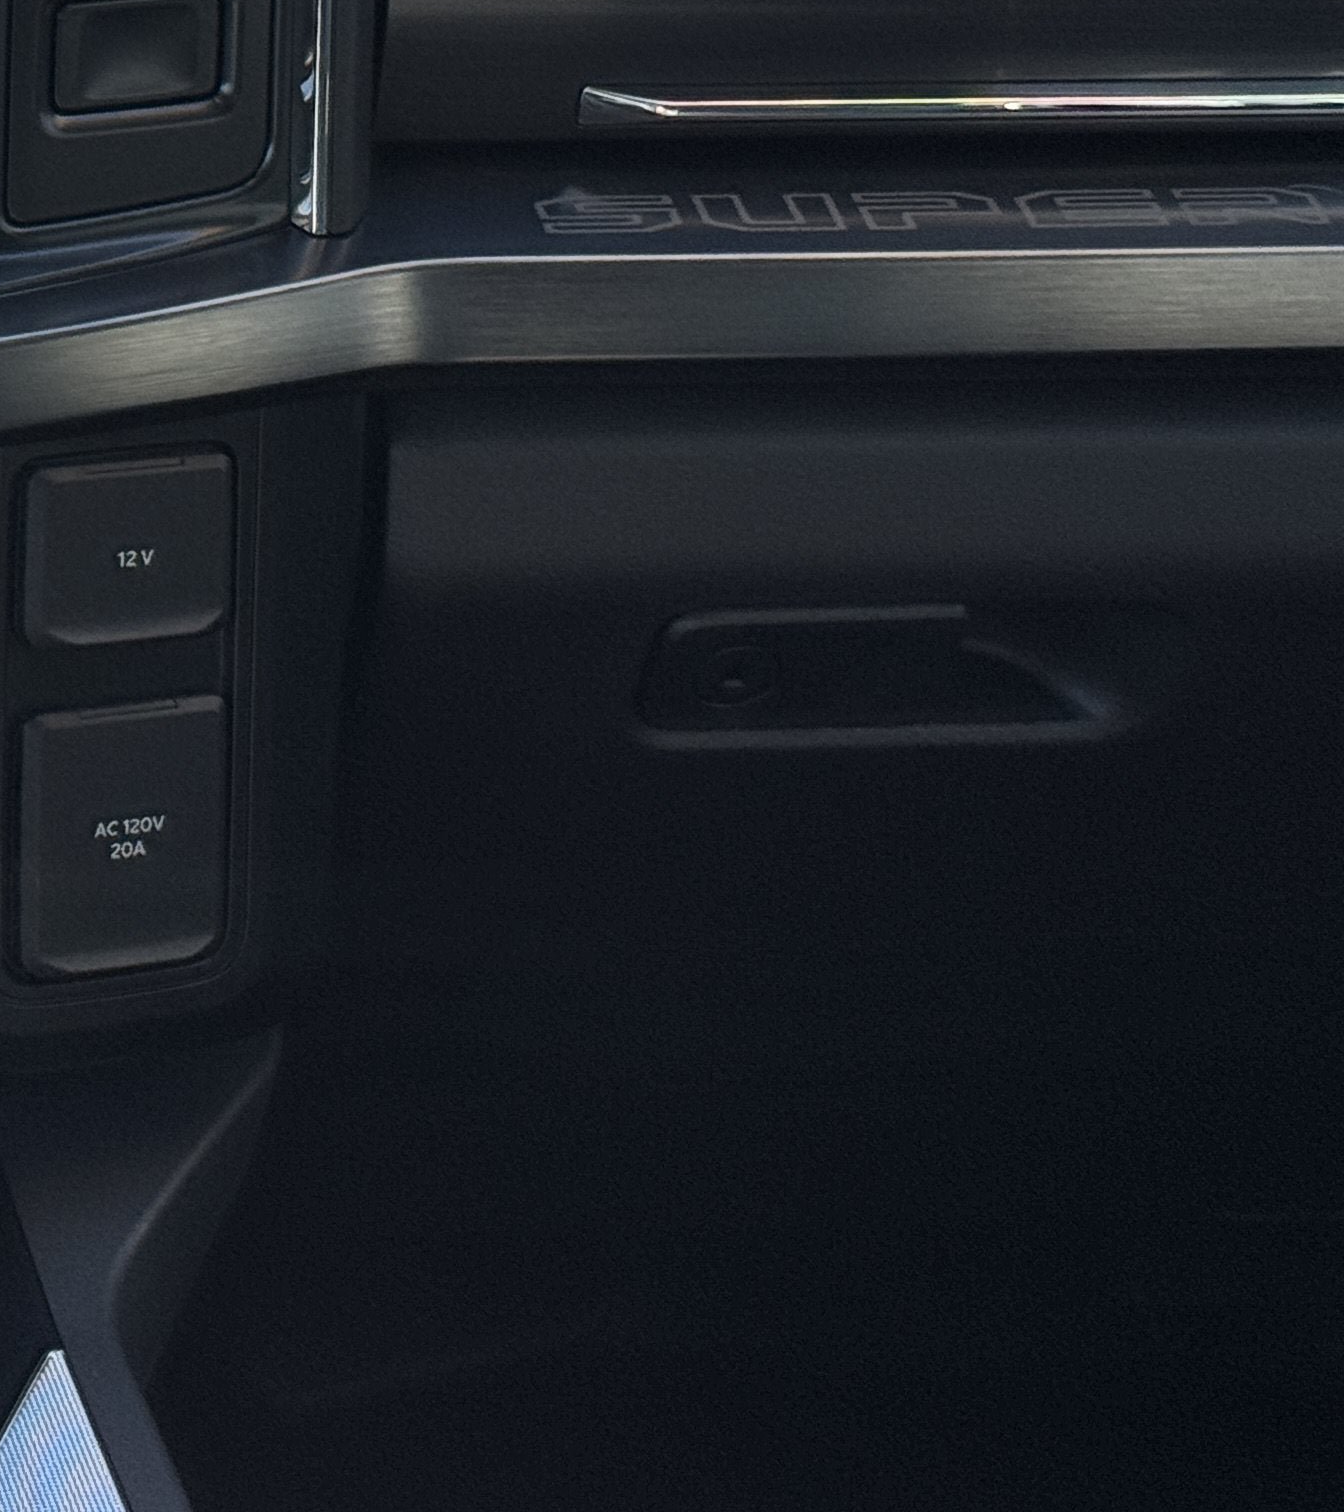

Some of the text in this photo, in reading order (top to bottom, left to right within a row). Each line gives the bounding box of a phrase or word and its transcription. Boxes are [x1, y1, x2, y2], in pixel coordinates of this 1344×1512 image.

[534, 187, 1330, 234] SUPER
[117, 548, 155, 568] 12 V
[94, 814, 165, 838] AC 120V
[110, 838, 146, 859] 20A
